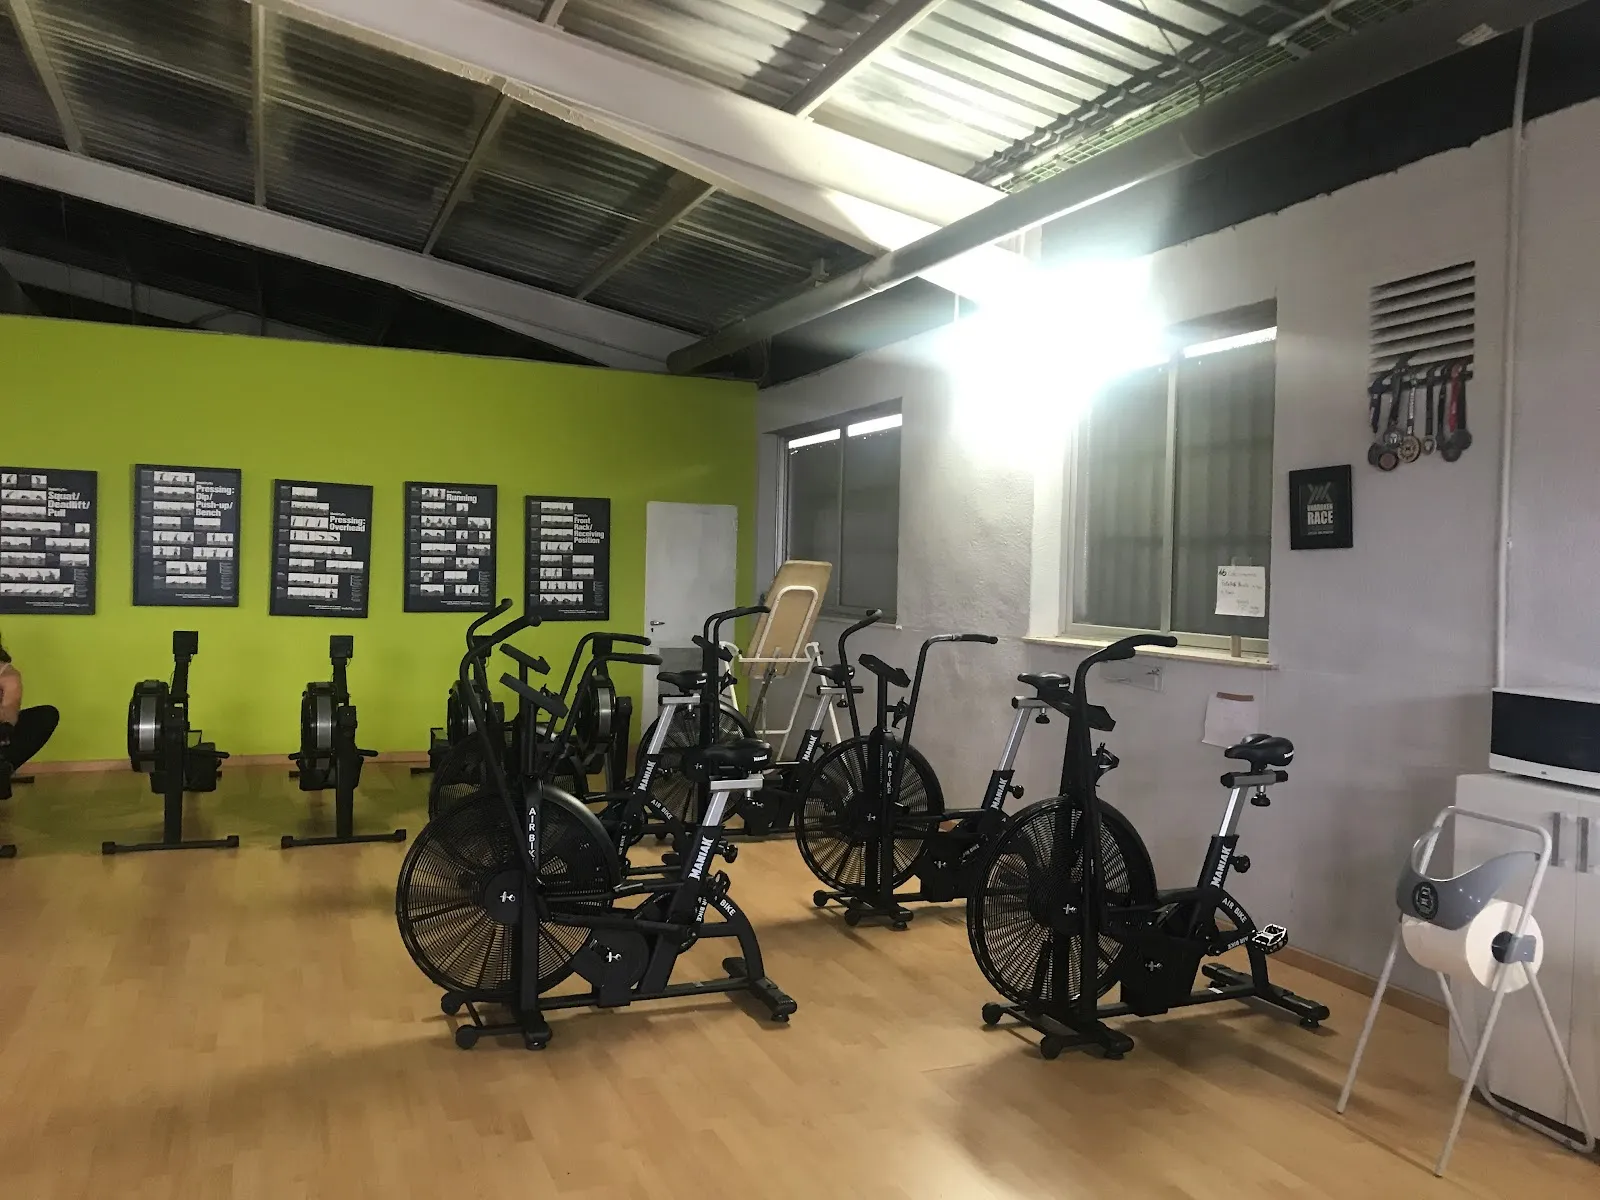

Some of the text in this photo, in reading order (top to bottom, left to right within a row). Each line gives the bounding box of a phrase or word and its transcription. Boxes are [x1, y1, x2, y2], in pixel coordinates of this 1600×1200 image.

[48, 491, 80, 501] Squat/
[196, 484, 235, 496] Pressing:
[196, 492, 213, 502] Dip/
[446, 493, 478, 505] Running
[48, 499, 91, 510] Deadlift/
[196, 500, 234, 511] Push-up/
[48, 508, 66, 517] Pull
[196, 508, 222, 517] Bench
[1307, 510, 1334, 526] RACE
[329, 515, 366, 527] Pressing:
[574, 516, 591, 525] Front
[329, 522, 366, 533] Overhead
[574, 523, 593, 531] Rack/
[574, 530, 605, 540] Receiving
[574, 536, 601, 545] Position
[802, 734, 818, 762] MANIAK
[638, 760, 657, 791] MANIAK
[990, 777, 1008, 810] MANIAK
[650, 799, 674, 820] AIR BIKE
[528, 807, 537, 864] AIR BIK
[688, 835, 714, 881] MANIAK
[1210, 844, 1232, 888] MANIAK
[719, 899, 737, 917] BIKE
[1222, 897, 1248, 924] AIR BIKE
